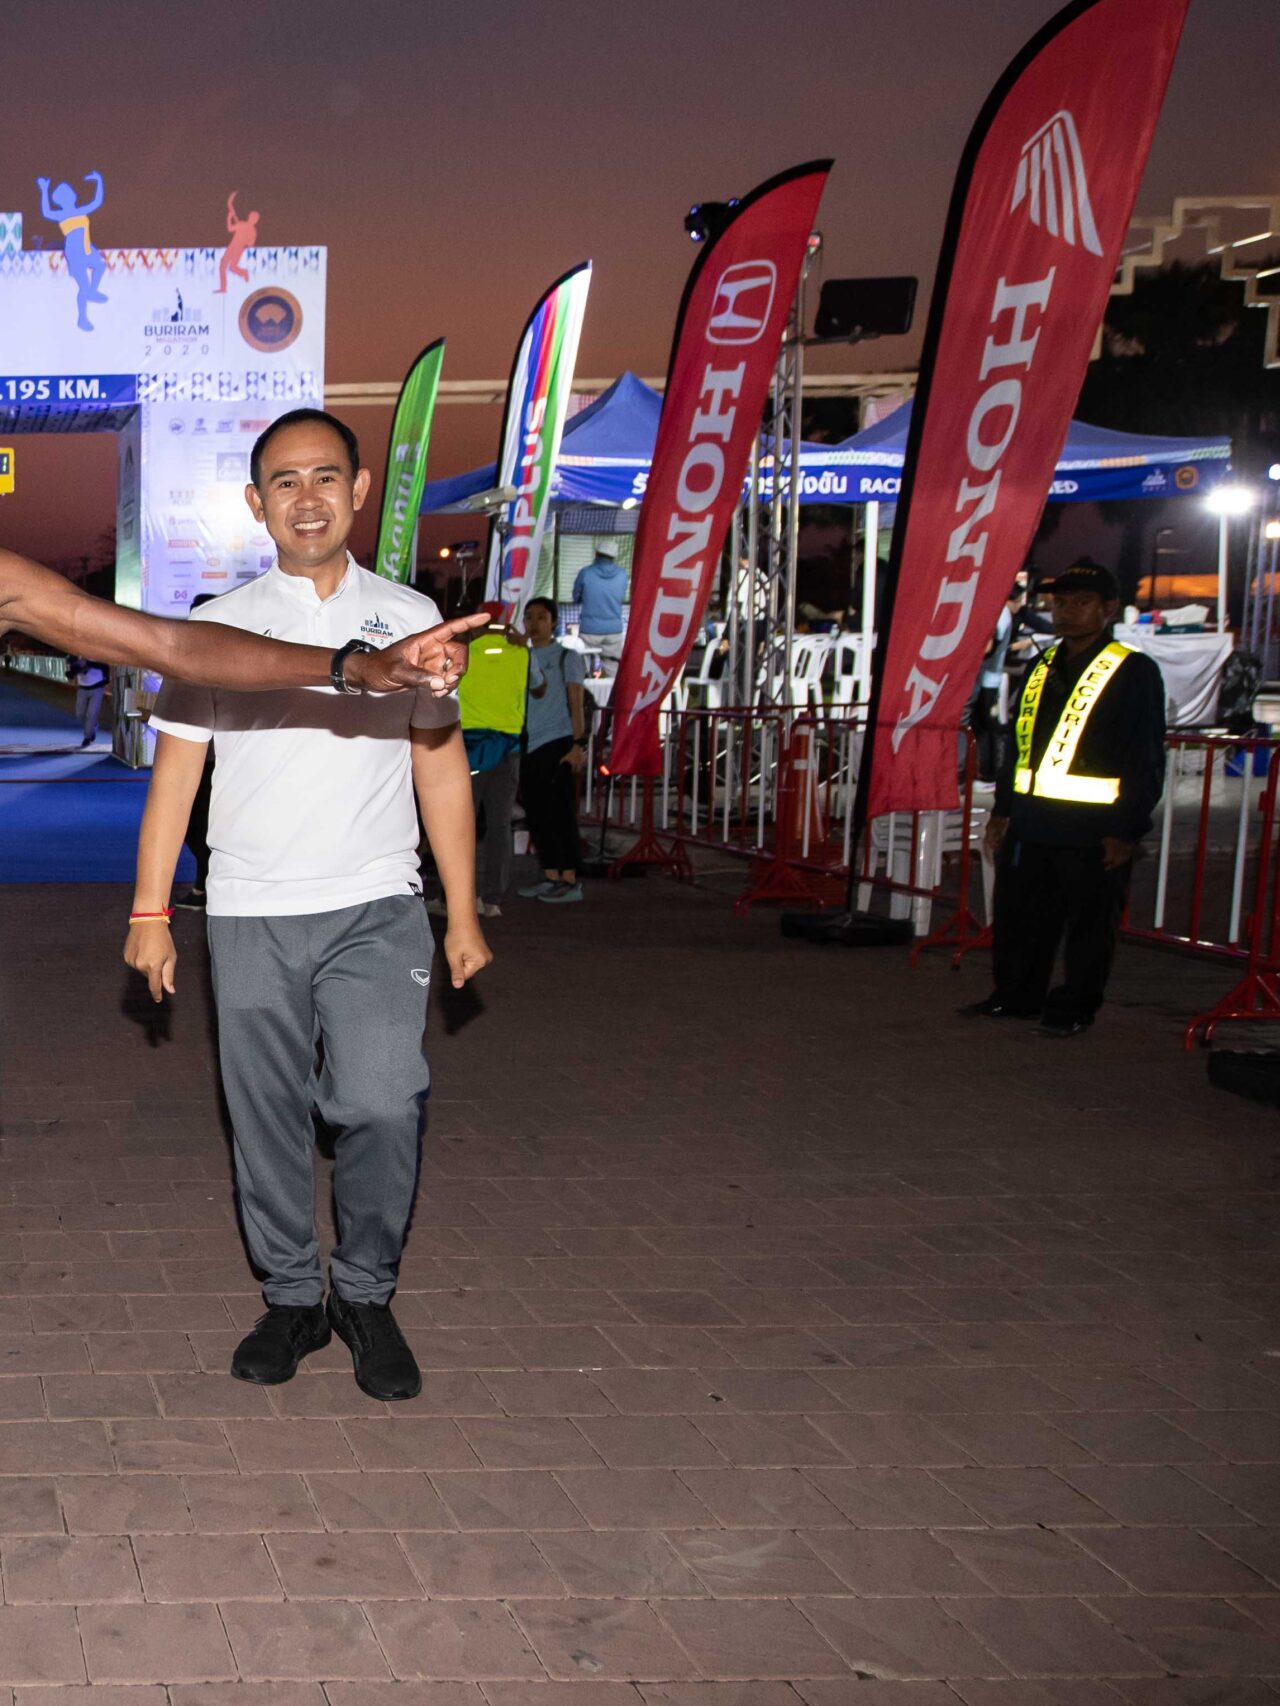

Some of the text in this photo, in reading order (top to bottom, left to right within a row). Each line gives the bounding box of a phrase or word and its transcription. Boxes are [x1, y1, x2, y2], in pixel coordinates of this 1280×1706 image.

[144, 325, 209, 337] BURIRAM
[59, 378, 107, 400] KM.
[626, 361, 747, 726] HONDA
[360, 626, 393, 638] BURIRAM
[1051, 660, 1113, 767] SECURITY
